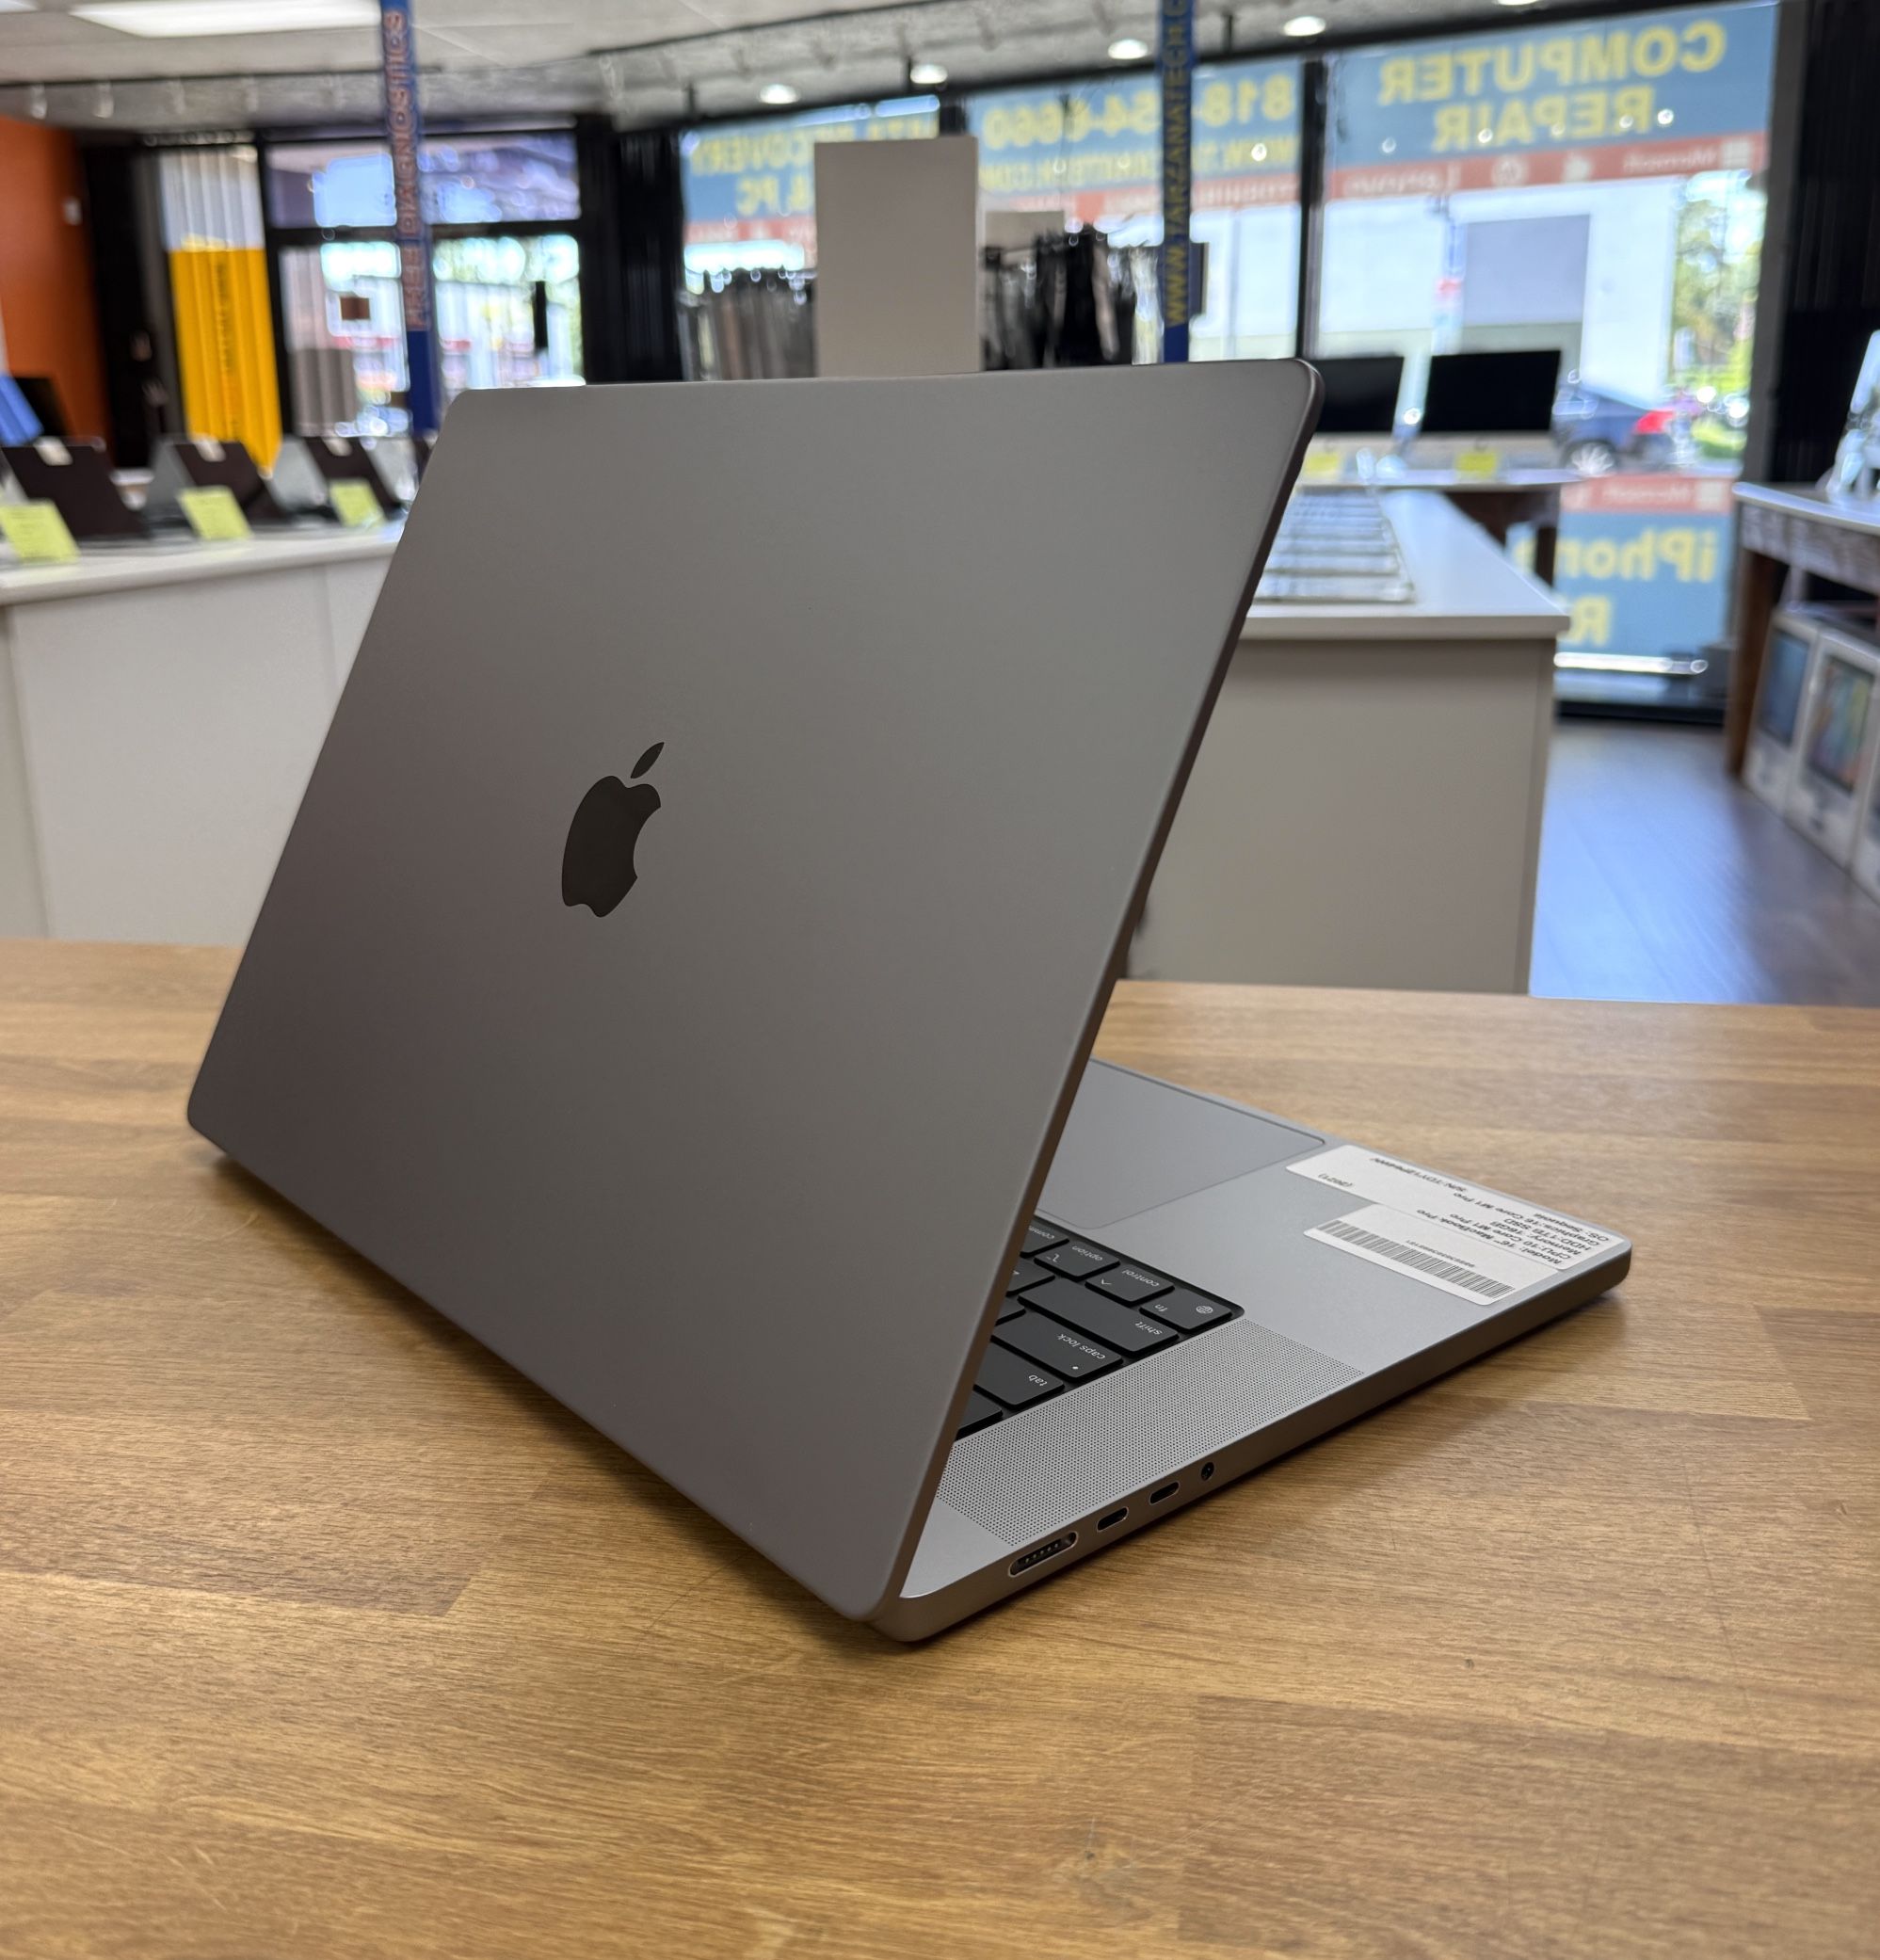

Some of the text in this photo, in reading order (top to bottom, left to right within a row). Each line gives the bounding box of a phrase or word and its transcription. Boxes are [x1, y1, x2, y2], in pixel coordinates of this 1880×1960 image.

[384, 10, 422, 236] DIAGNOSTICS
[1439, 1217, 1494, 1239] MacBook
[1071, 1245, 1104, 1261] option
[1121, 1269, 1160, 1287] control
[1154, 1303, 1168, 1312] fn
[1134, 1320, 1163, 1335] shift
[1057, 1332, 1106, 1359] caps lock
[1028, 1374, 1048, 1387] tab
